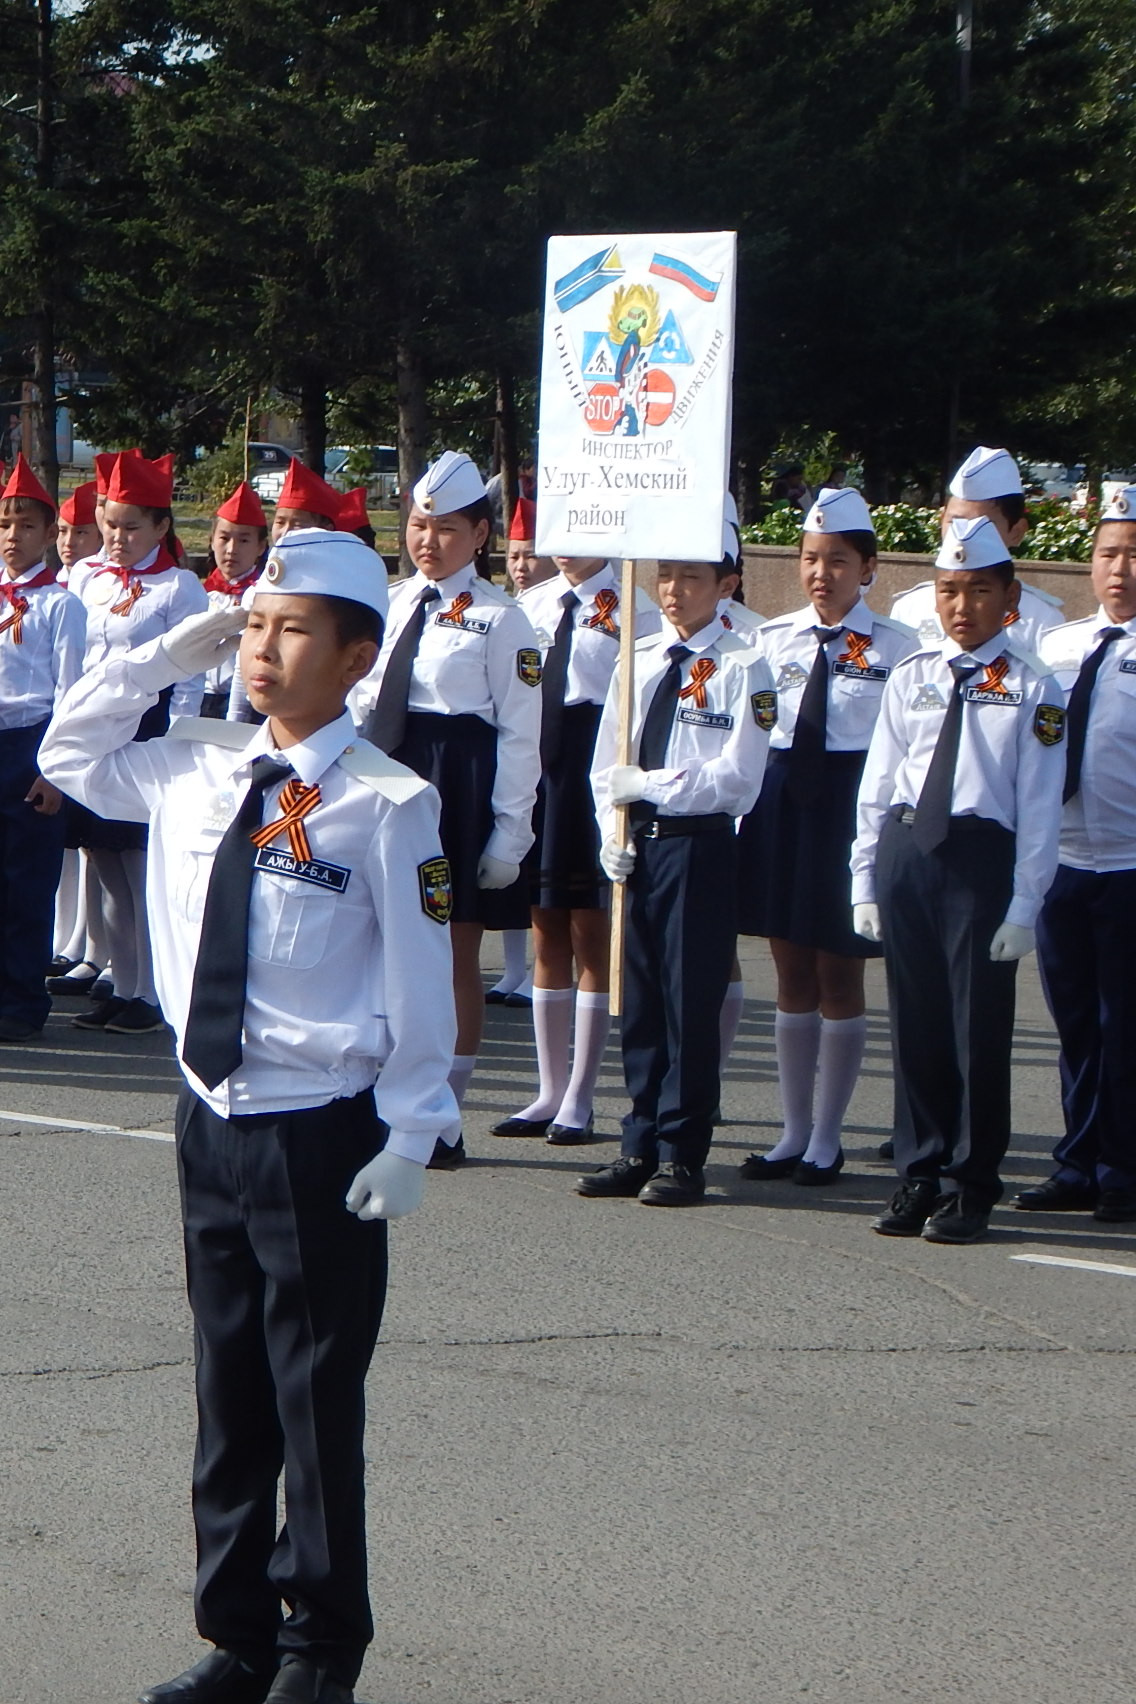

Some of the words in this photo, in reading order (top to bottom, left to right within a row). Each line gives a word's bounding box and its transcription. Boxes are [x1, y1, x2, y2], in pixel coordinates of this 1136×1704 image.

[554, 324, 587, 407] ЮНЫЙ
[672, 329, 724, 424] ДВИЖЕНИЯ
[585, 395, 621, 420] STOP
[582, 438, 673, 460] ИНСПЕКТОР
[544, 465, 687, 495] Улуг-Хемский
[567, 503, 626, 533] район
[266, 855, 298, 872] АЖЫ
[298, 862, 333, 882] У-Б.А.
